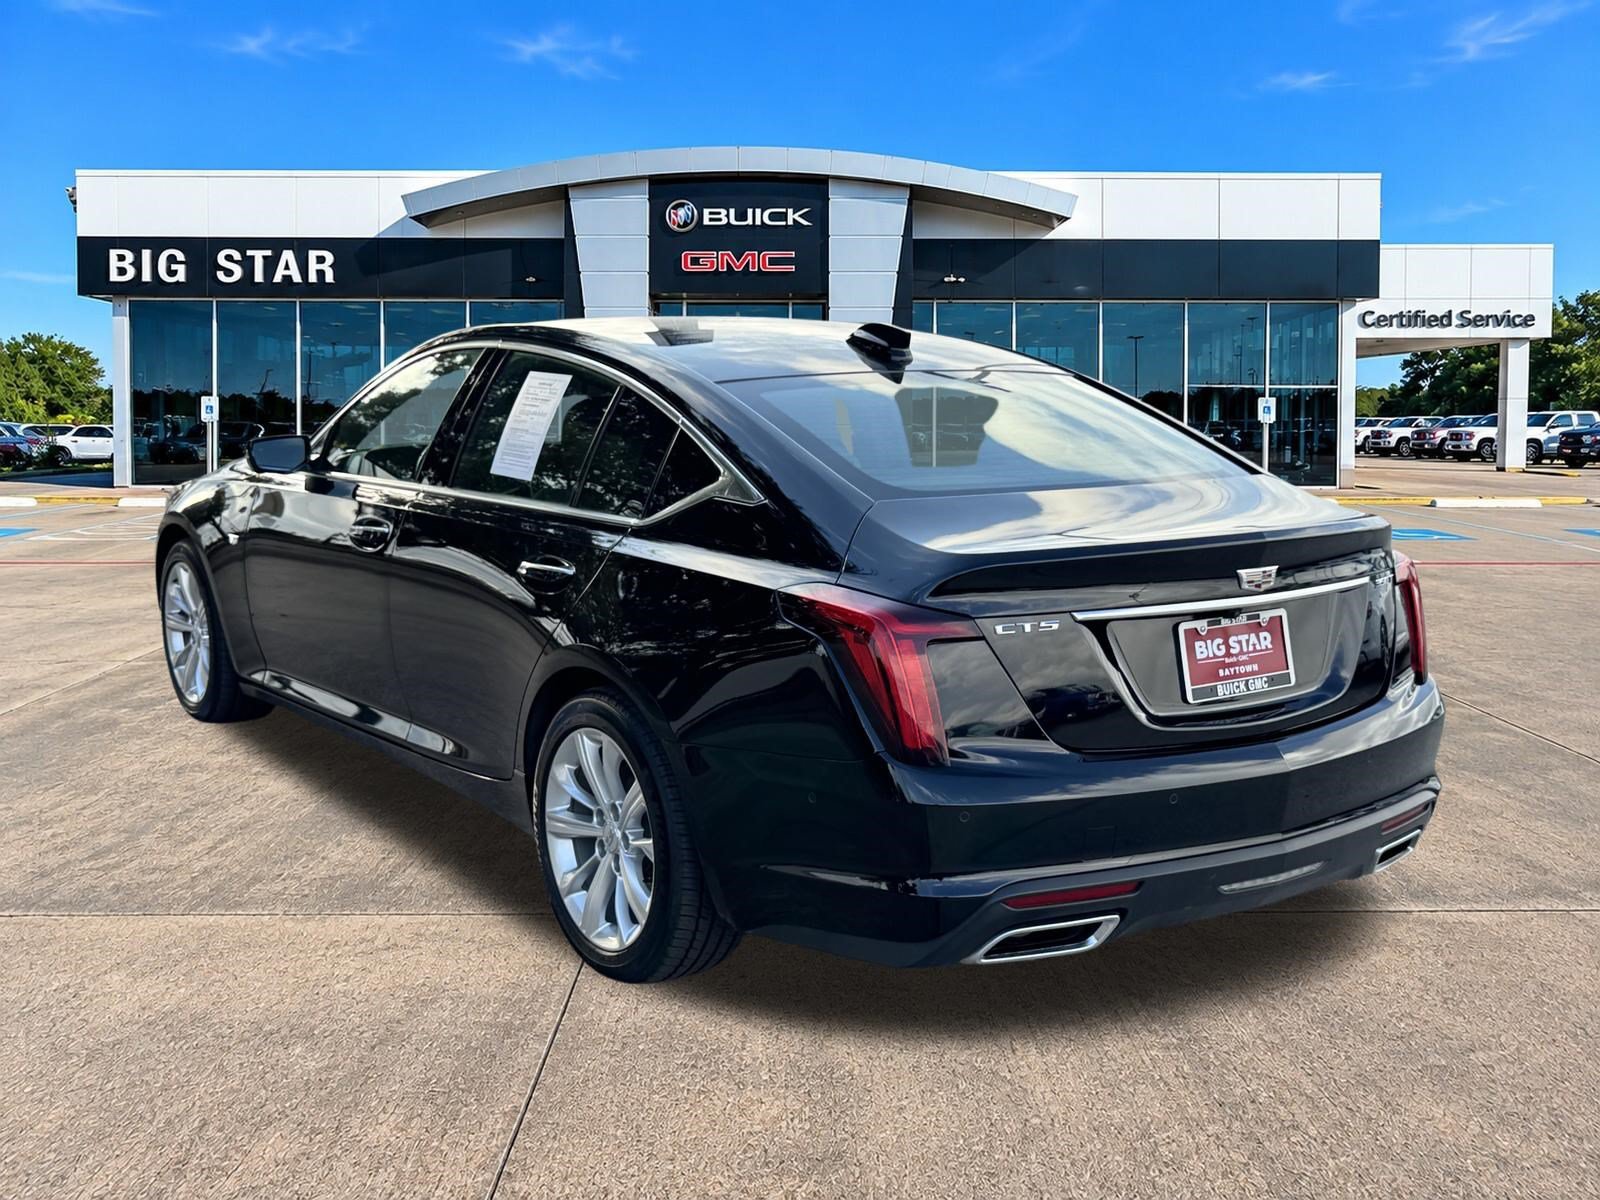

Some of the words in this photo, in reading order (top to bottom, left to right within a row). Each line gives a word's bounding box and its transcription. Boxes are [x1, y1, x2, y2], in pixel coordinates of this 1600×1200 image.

[702, 207, 813, 226] BUICK
[108, 248, 187, 283] BIG
[216, 248, 336, 283] STAR
[681, 251, 796, 272] GMC
[1358, 309, 1453, 329] Certified
[1455, 309, 1536, 329] Service
[1195, 638, 1226, 659] BIG
[1229, 632, 1272, 653] STAR
[1219, 664, 1258, 676] BAYTOWN
[1217, 681, 1247, 696] BUICK
[1248, 677, 1268, 690] GMC
